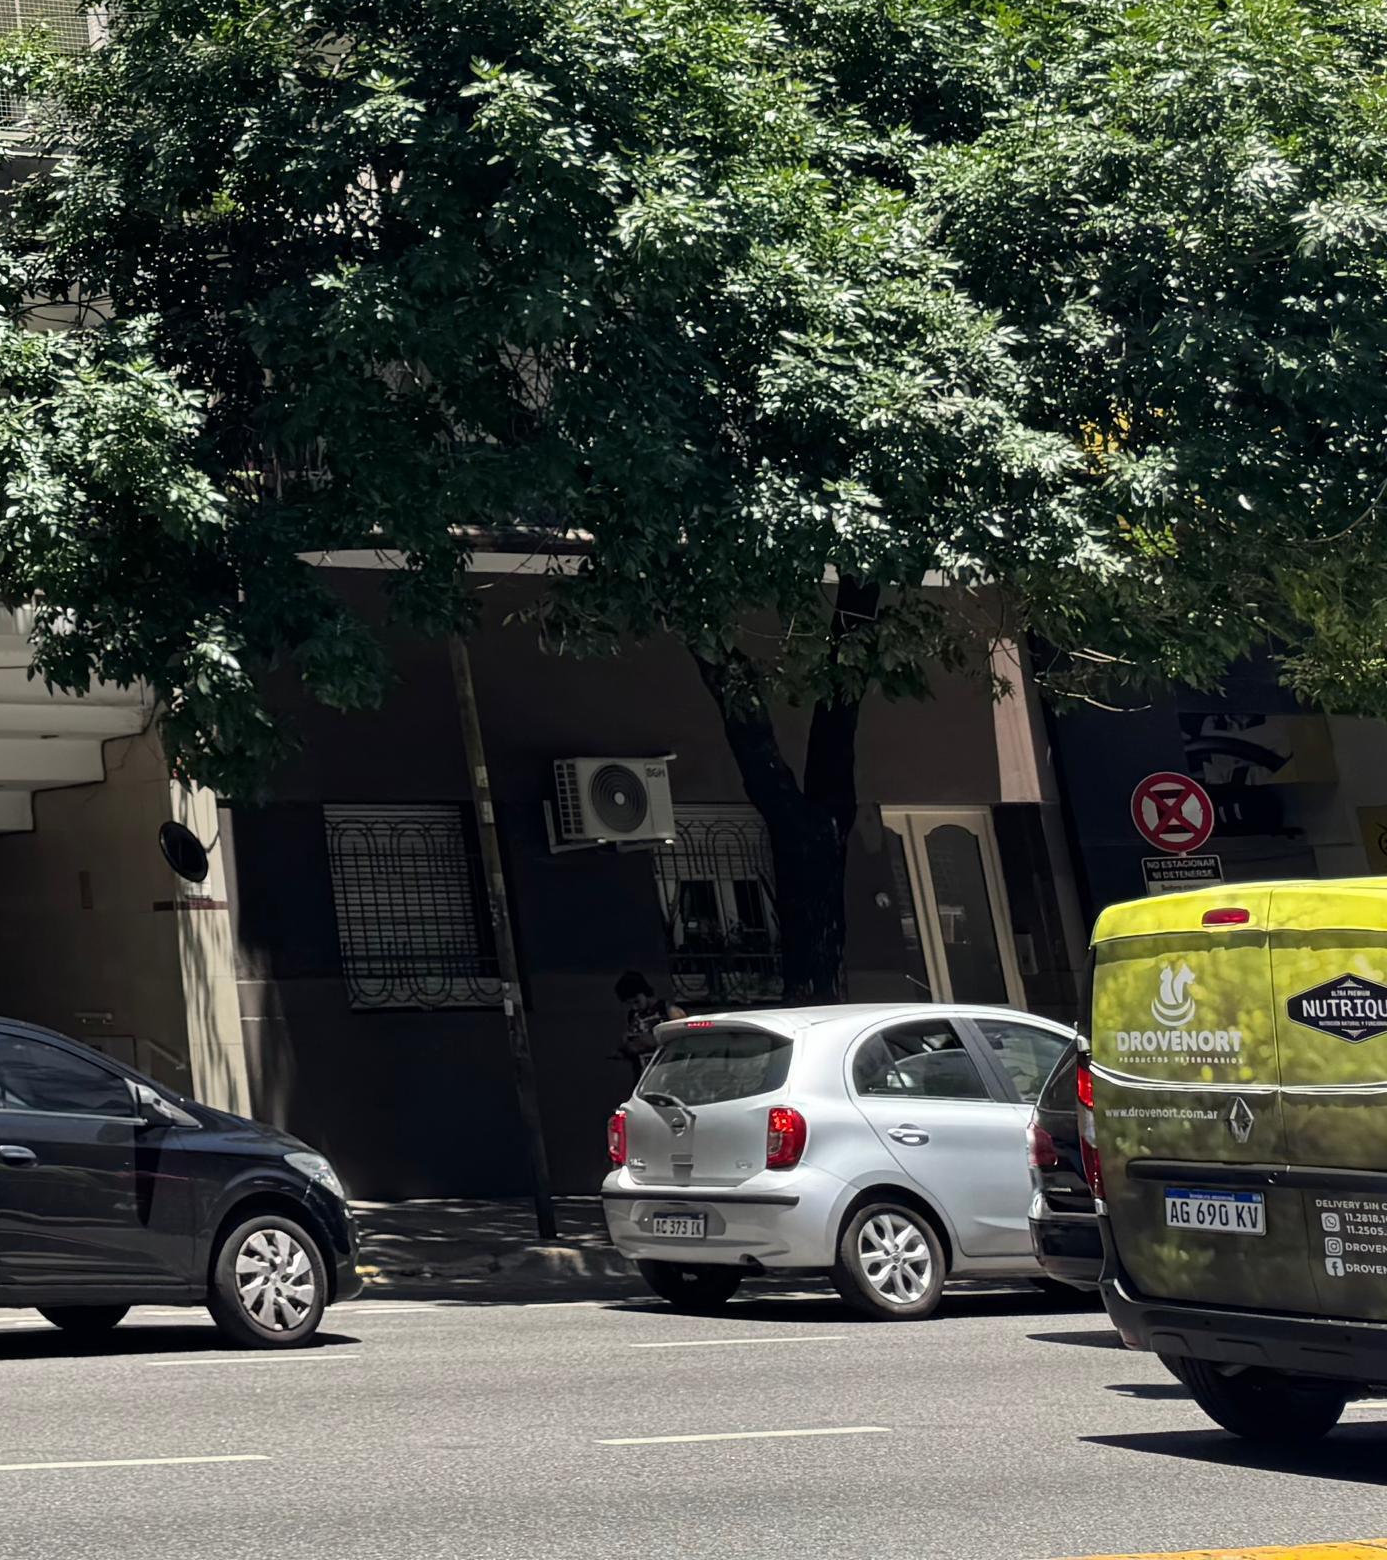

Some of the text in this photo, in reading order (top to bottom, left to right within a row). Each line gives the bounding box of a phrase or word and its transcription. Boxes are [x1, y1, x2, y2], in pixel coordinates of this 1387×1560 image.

[1147, 858, 1215, 869] NO ESTACIONAR
[1152, 869, 1214, 879] NI DETENERSE
[1116, 1030, 1243, 1053] DROVENORT
[1119, 1056, 1244, 1065] PRODUCTOS VETERINARIOS
[1105, 1106, 1218, 1120] www.drovenort.com.ar
[1315, 1199, 1361, 1210] DELIVERY
[1363, 1201, 1380, 1211] SIN
[1170, 1201, 1258, 1229] AG 690 KV
